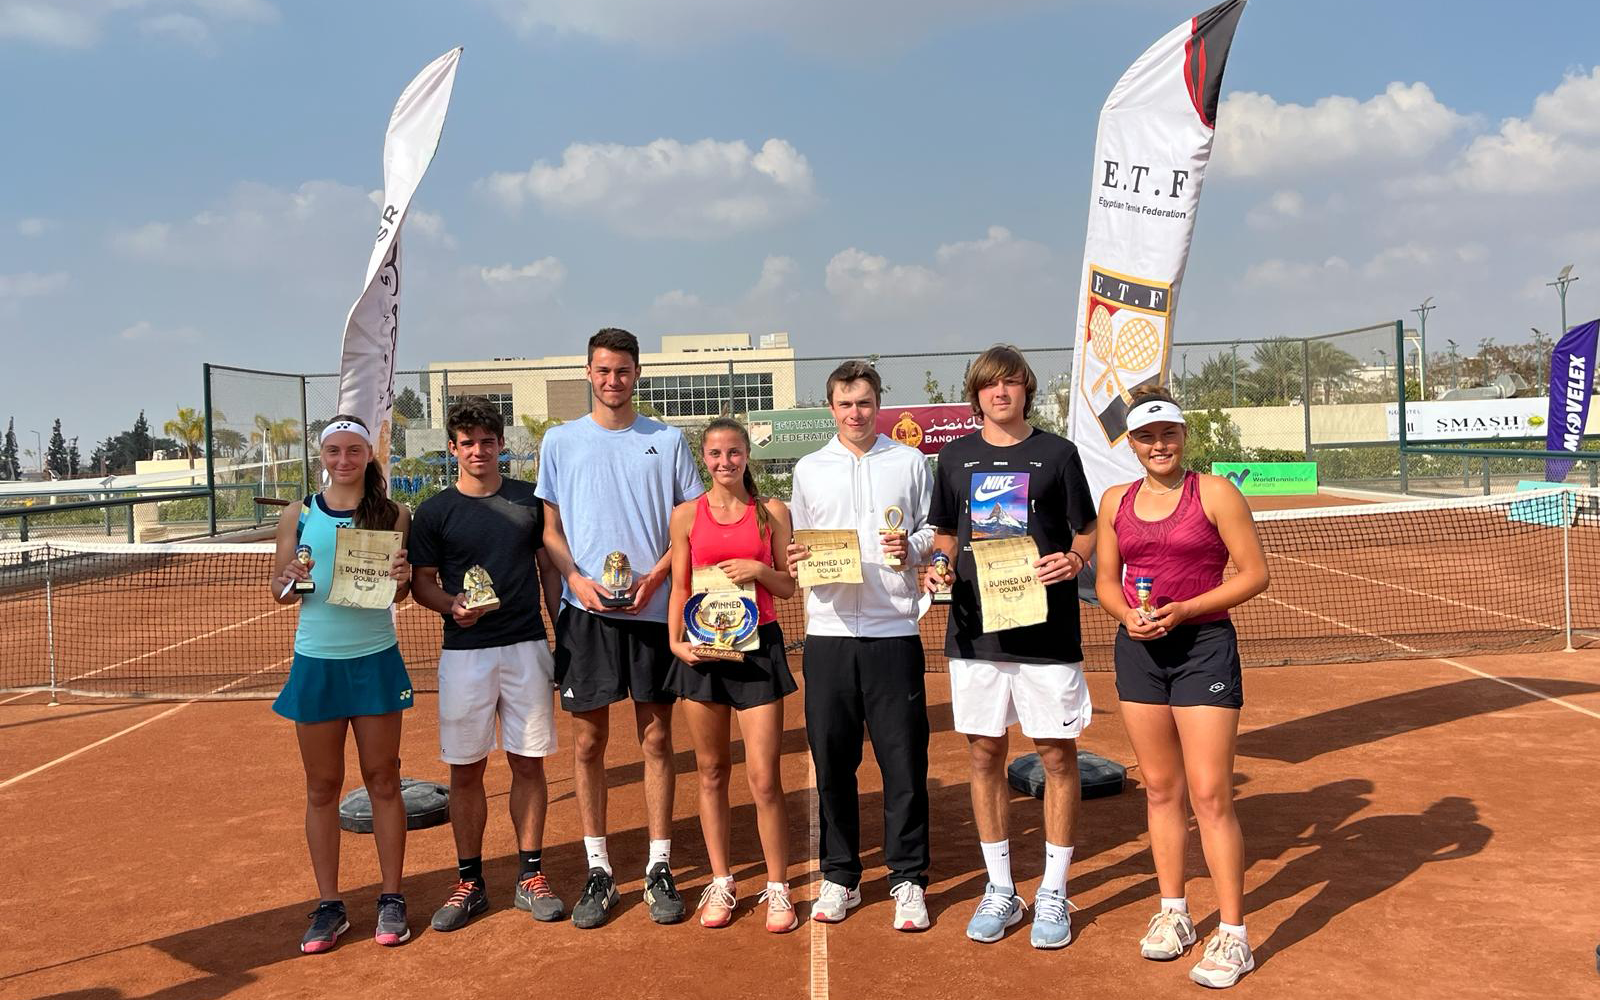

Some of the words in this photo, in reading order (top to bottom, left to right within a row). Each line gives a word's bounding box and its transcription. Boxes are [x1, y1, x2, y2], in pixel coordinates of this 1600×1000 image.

[1099, 196, 1124, 210] Egyptian
[1125, 202, 1140, 213] Tennis
[1141, 206, 1187, 219] Federation
[1563, 353, 1586, 453] MOVELEX
[775, 419, 813, 431] EGYPTIAN
[814, 418, 838, 429] TENNI
[1436, 416, 1519, 429] SMASH
[775, 430, 837, 443] FEDERATIO
[981, 475, 1016, 490] NIKE
[808, 559, 837, 567] RUNNER
[840, 558, 851, 566] UP
[345, 566, 376, 576] RUNNER
[989, 577, 1019, 588] RUNNER
[1020, 575, 1032, 584] UP
[999, 584, 1026, 594] DOUBLES
[709, 600, 742, 610] WINNER
